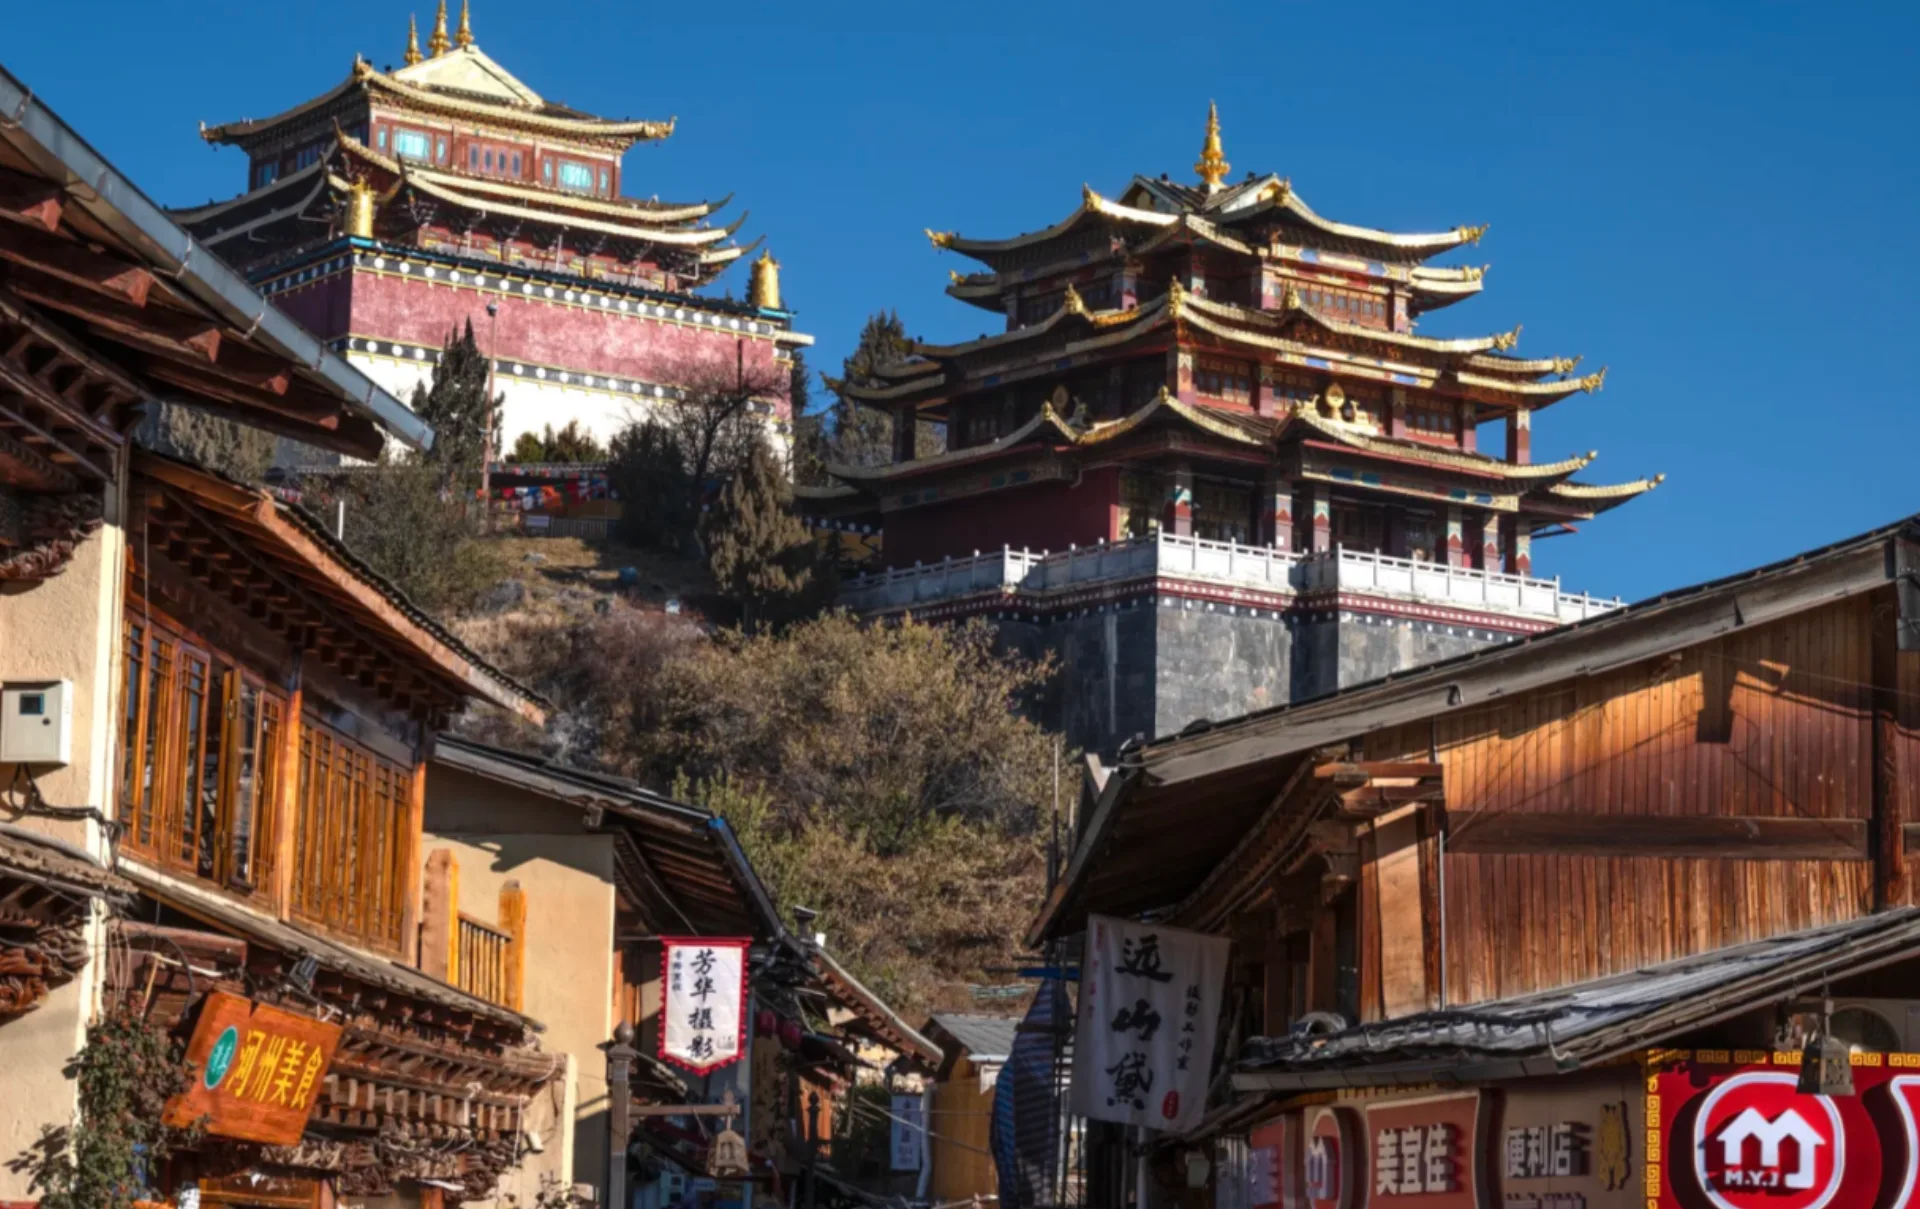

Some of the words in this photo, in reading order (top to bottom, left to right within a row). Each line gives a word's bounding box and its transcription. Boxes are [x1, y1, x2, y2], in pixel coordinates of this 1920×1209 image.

[686, 948, 717, 1060] 芳华摄影
[1104, 933, 1174, 1111] 远山黛
[225, 1029, 323, 1109] 河州美食
[1376, 1123, 1447, 1195] 美宜佳
[1505, 1123, 1571, 1177] 便利店
